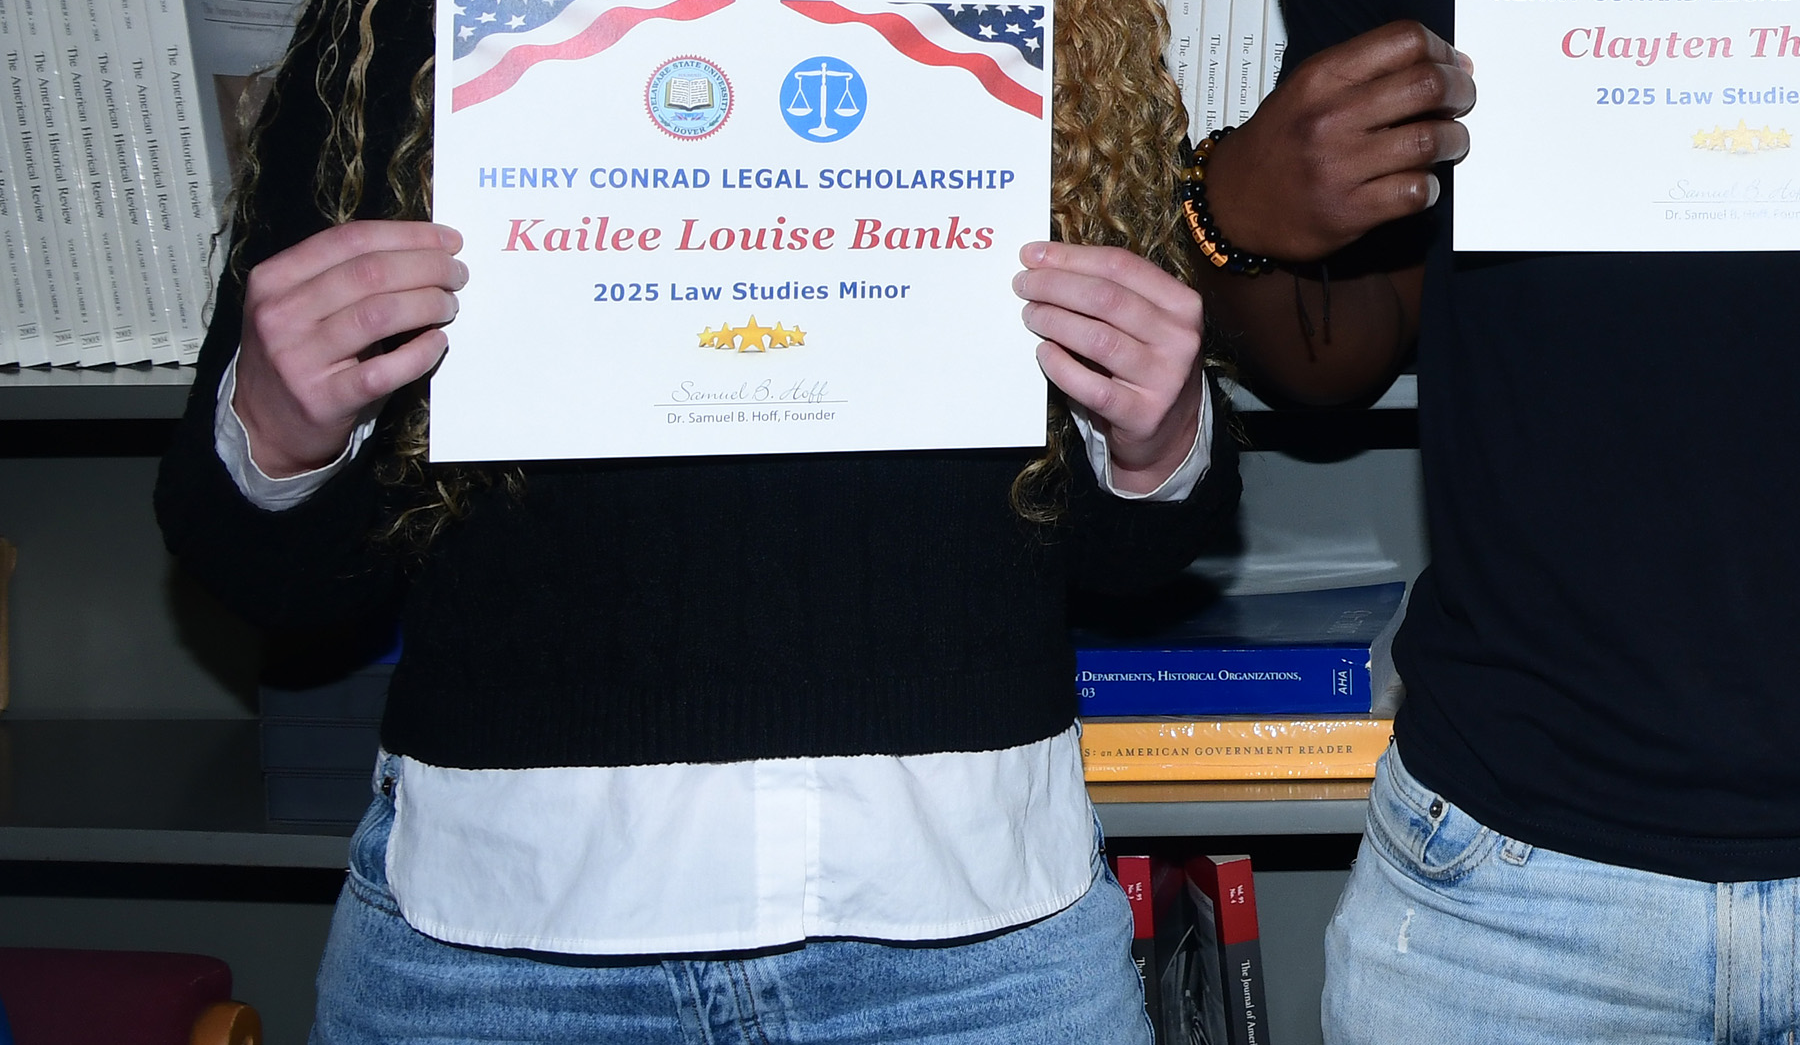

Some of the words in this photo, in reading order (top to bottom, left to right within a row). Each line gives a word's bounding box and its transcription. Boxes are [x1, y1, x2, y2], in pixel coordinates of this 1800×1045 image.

[1561, 26, 1734, 67] Clayten
[651, 67, 671, 113] DELAWARE
[672, 60, 702, 69] STATE
[703, 65, 728, 114] UNIVERSITY
[1595, 88, 1656, 106] 2025
[1666, 88, 1713, 105] Law
[673, 126, 706, 135] DOVER
[478, 166, 579, 189] HENRY
[589, 167, 711, 190] CONRAD
[722, 168, 808, 190] LEGAL
[819, 168, 1016, 191] SCHOLARSHIP
[1665, 209, 1681, 220] Dr.
[1685, 209, 1727, 220] Samuel
[502, 215, 662, 253] Kailee
[676, 217, 835, 253] Louise
[849, 215, 995, 251] Banks
[593, 282, 660, 302] 2025
[671, 283, 725, 301] Law
[733, 281, 829, 301] Studies
[839, 280, 911, 300] Minor
[671, 380, 749, 403] Samuel
[752, 379, 774, 401] B.
[779, 378, 828, 403] Hoff
[667, 413, 685, 423] Dr.
[688, 411, 734, 423] Samuel
[737, 411, 748, 422] B.
[752, 410, 781, 423] Hoff,
[784, 410, 836, 421] Founder
[1082, 671, 1156, 682] DEPARTMENTS,
[1158, 670, 1216, 682] HISTORICAL
[1218, 670, 1302, 682] ORGANIZATIONS,
[1337, 670, 1348, 695] AHA
[1115, 747, 1190, 757] AMERICAN
[1195, 746, 1294, 756] GOVERNMENT
[1299, 745, 1353, 754] READER
